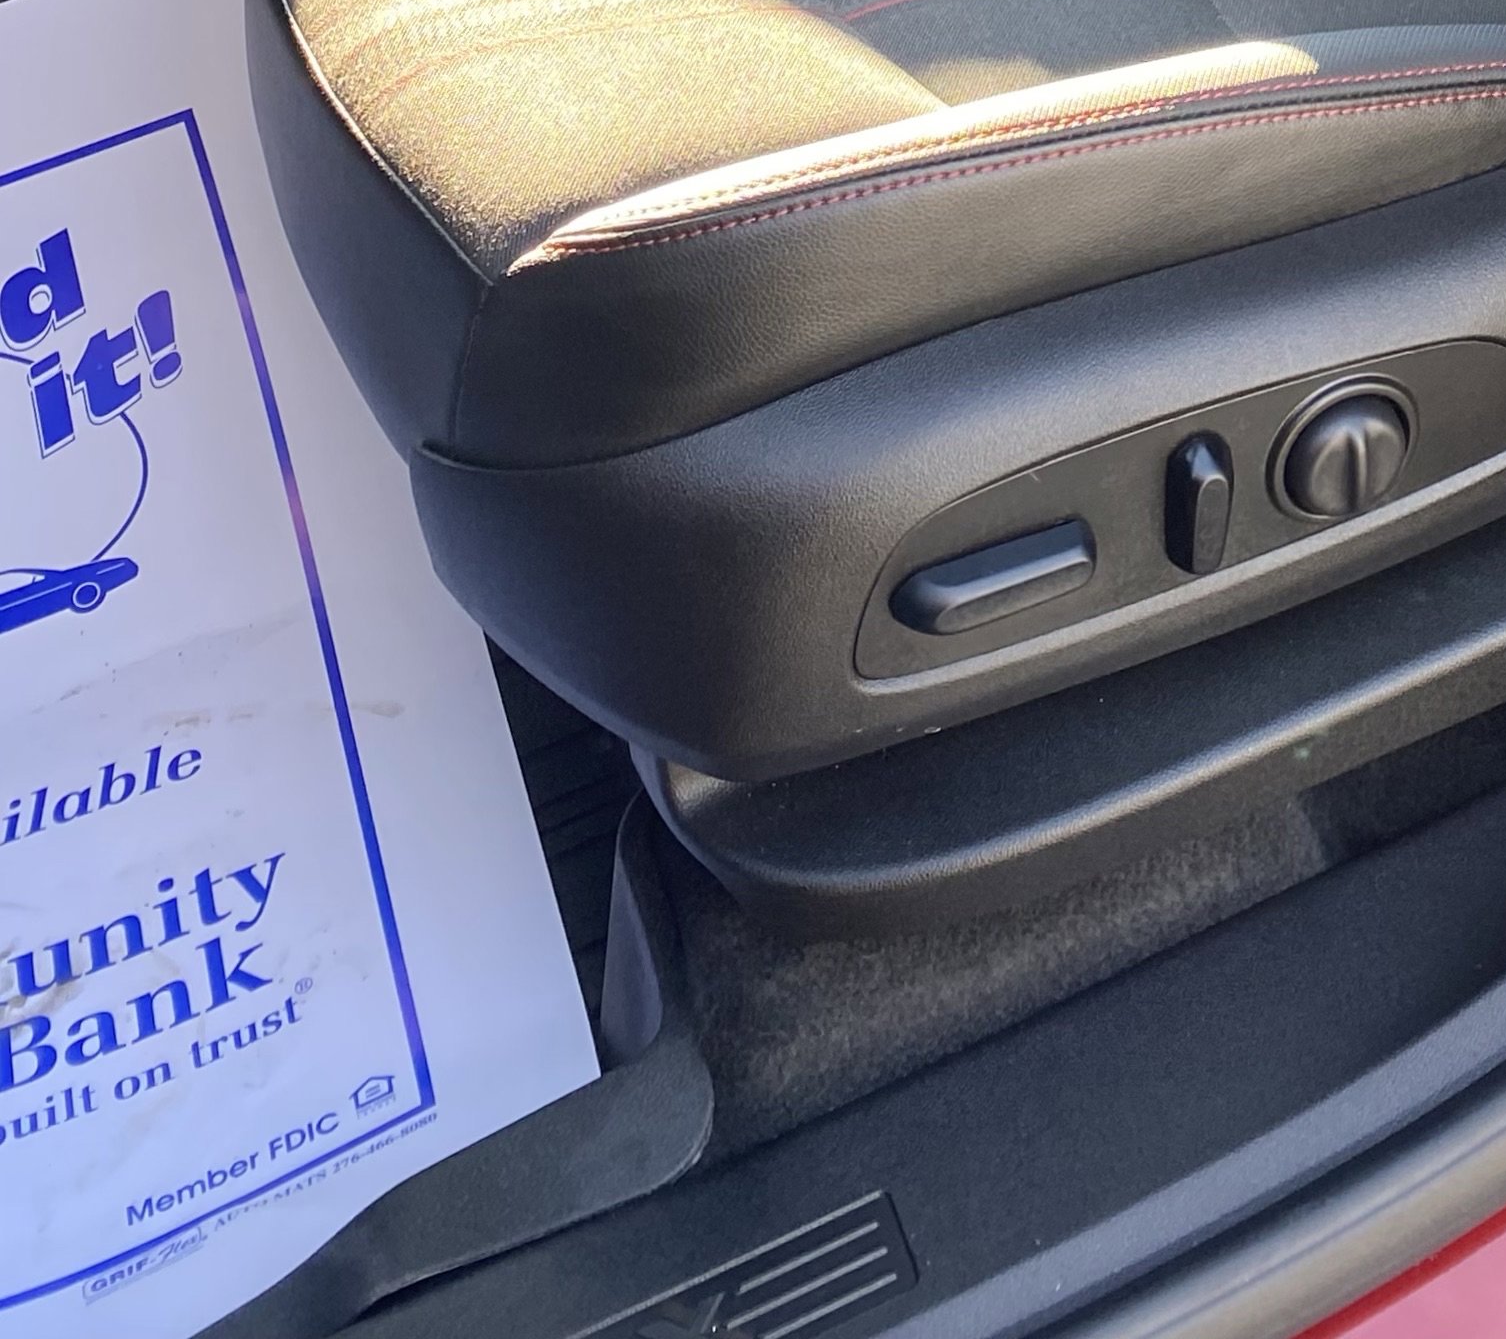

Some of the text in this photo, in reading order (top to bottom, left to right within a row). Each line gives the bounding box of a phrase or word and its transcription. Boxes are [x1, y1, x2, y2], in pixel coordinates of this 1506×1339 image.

[27, 290, 183, 459] it!
[0, 852, 286, 1007] unity
[0, 936, 273, 1093] Bank
[113, 1061, 175, 1101] on
[126, 1111, 341, 1227] Member FDIC
[332, 1112, 438, 1183] 276-466-8080
